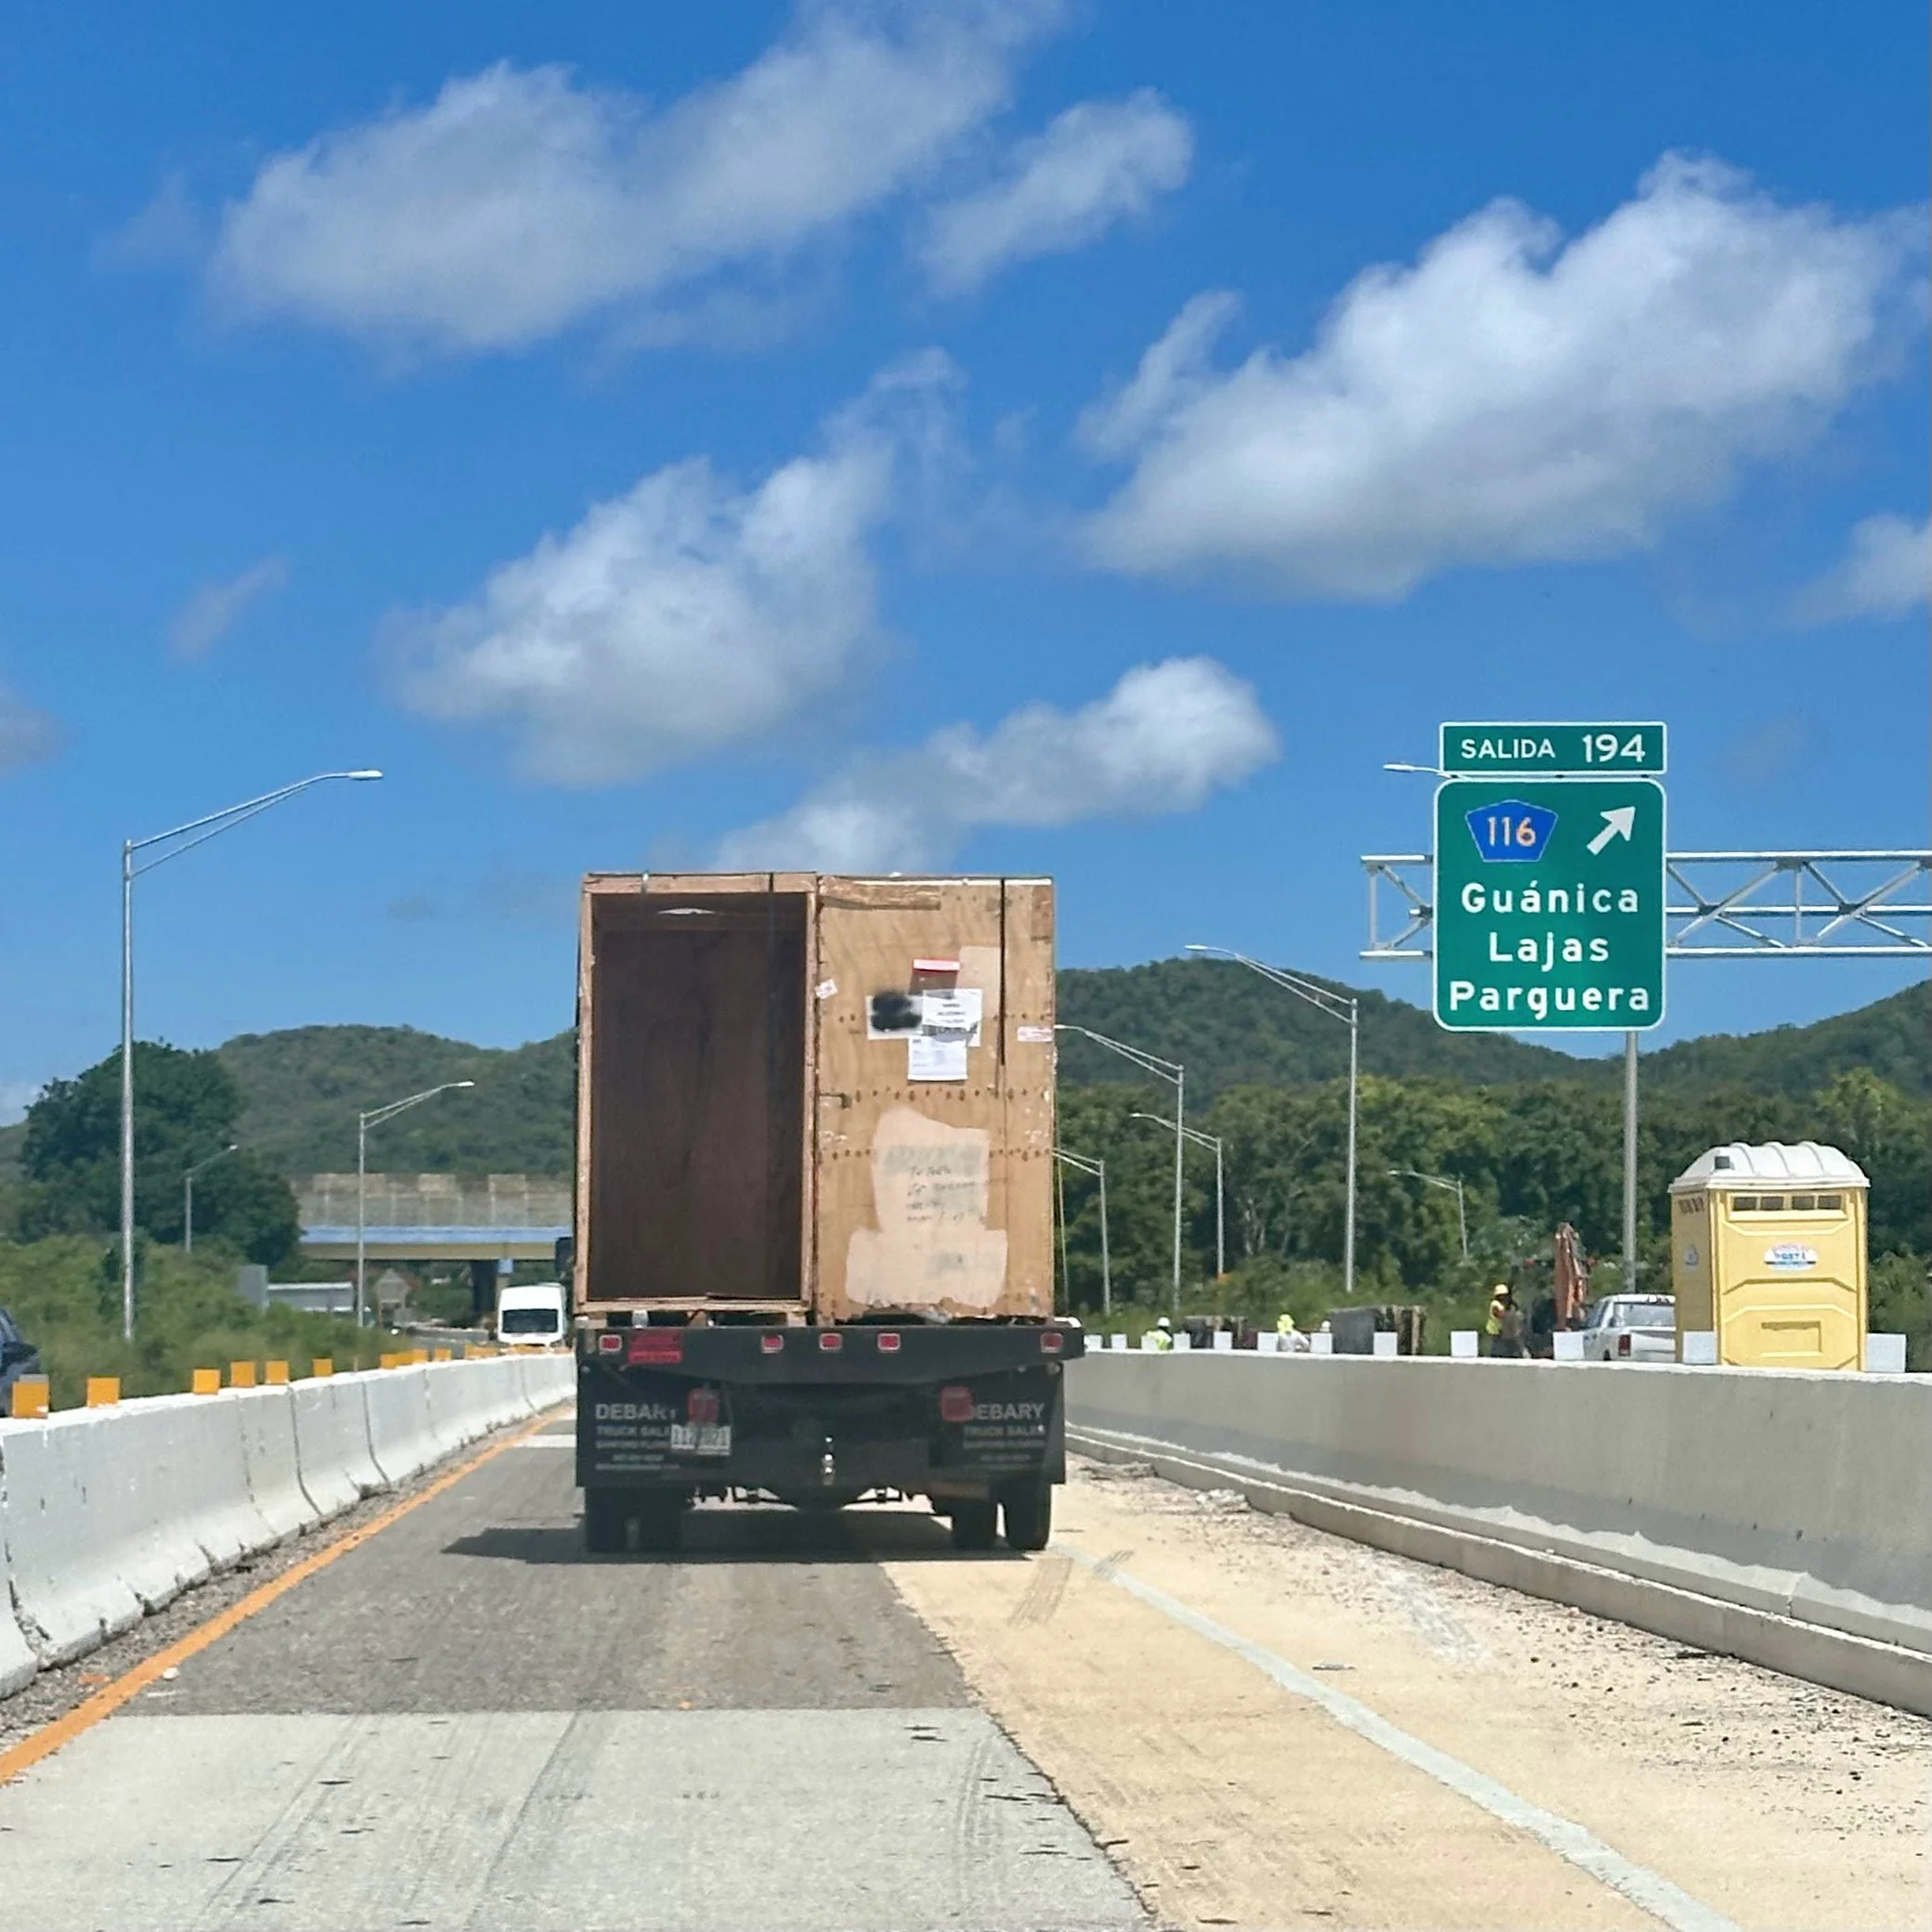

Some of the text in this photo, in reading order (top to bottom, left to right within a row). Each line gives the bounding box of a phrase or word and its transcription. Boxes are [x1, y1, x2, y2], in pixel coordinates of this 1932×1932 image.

[1460, 733, 1646, 763] SALIDA 194
[1487, 816, 1537, 847] 116
[1460, 879, 1640, 914] Guánica
[1488, 931, 1610, 972] Lajas
[1449, 979, 1650, 1020] Parguera
[972, 1403, 1045, 1420] EBARY
